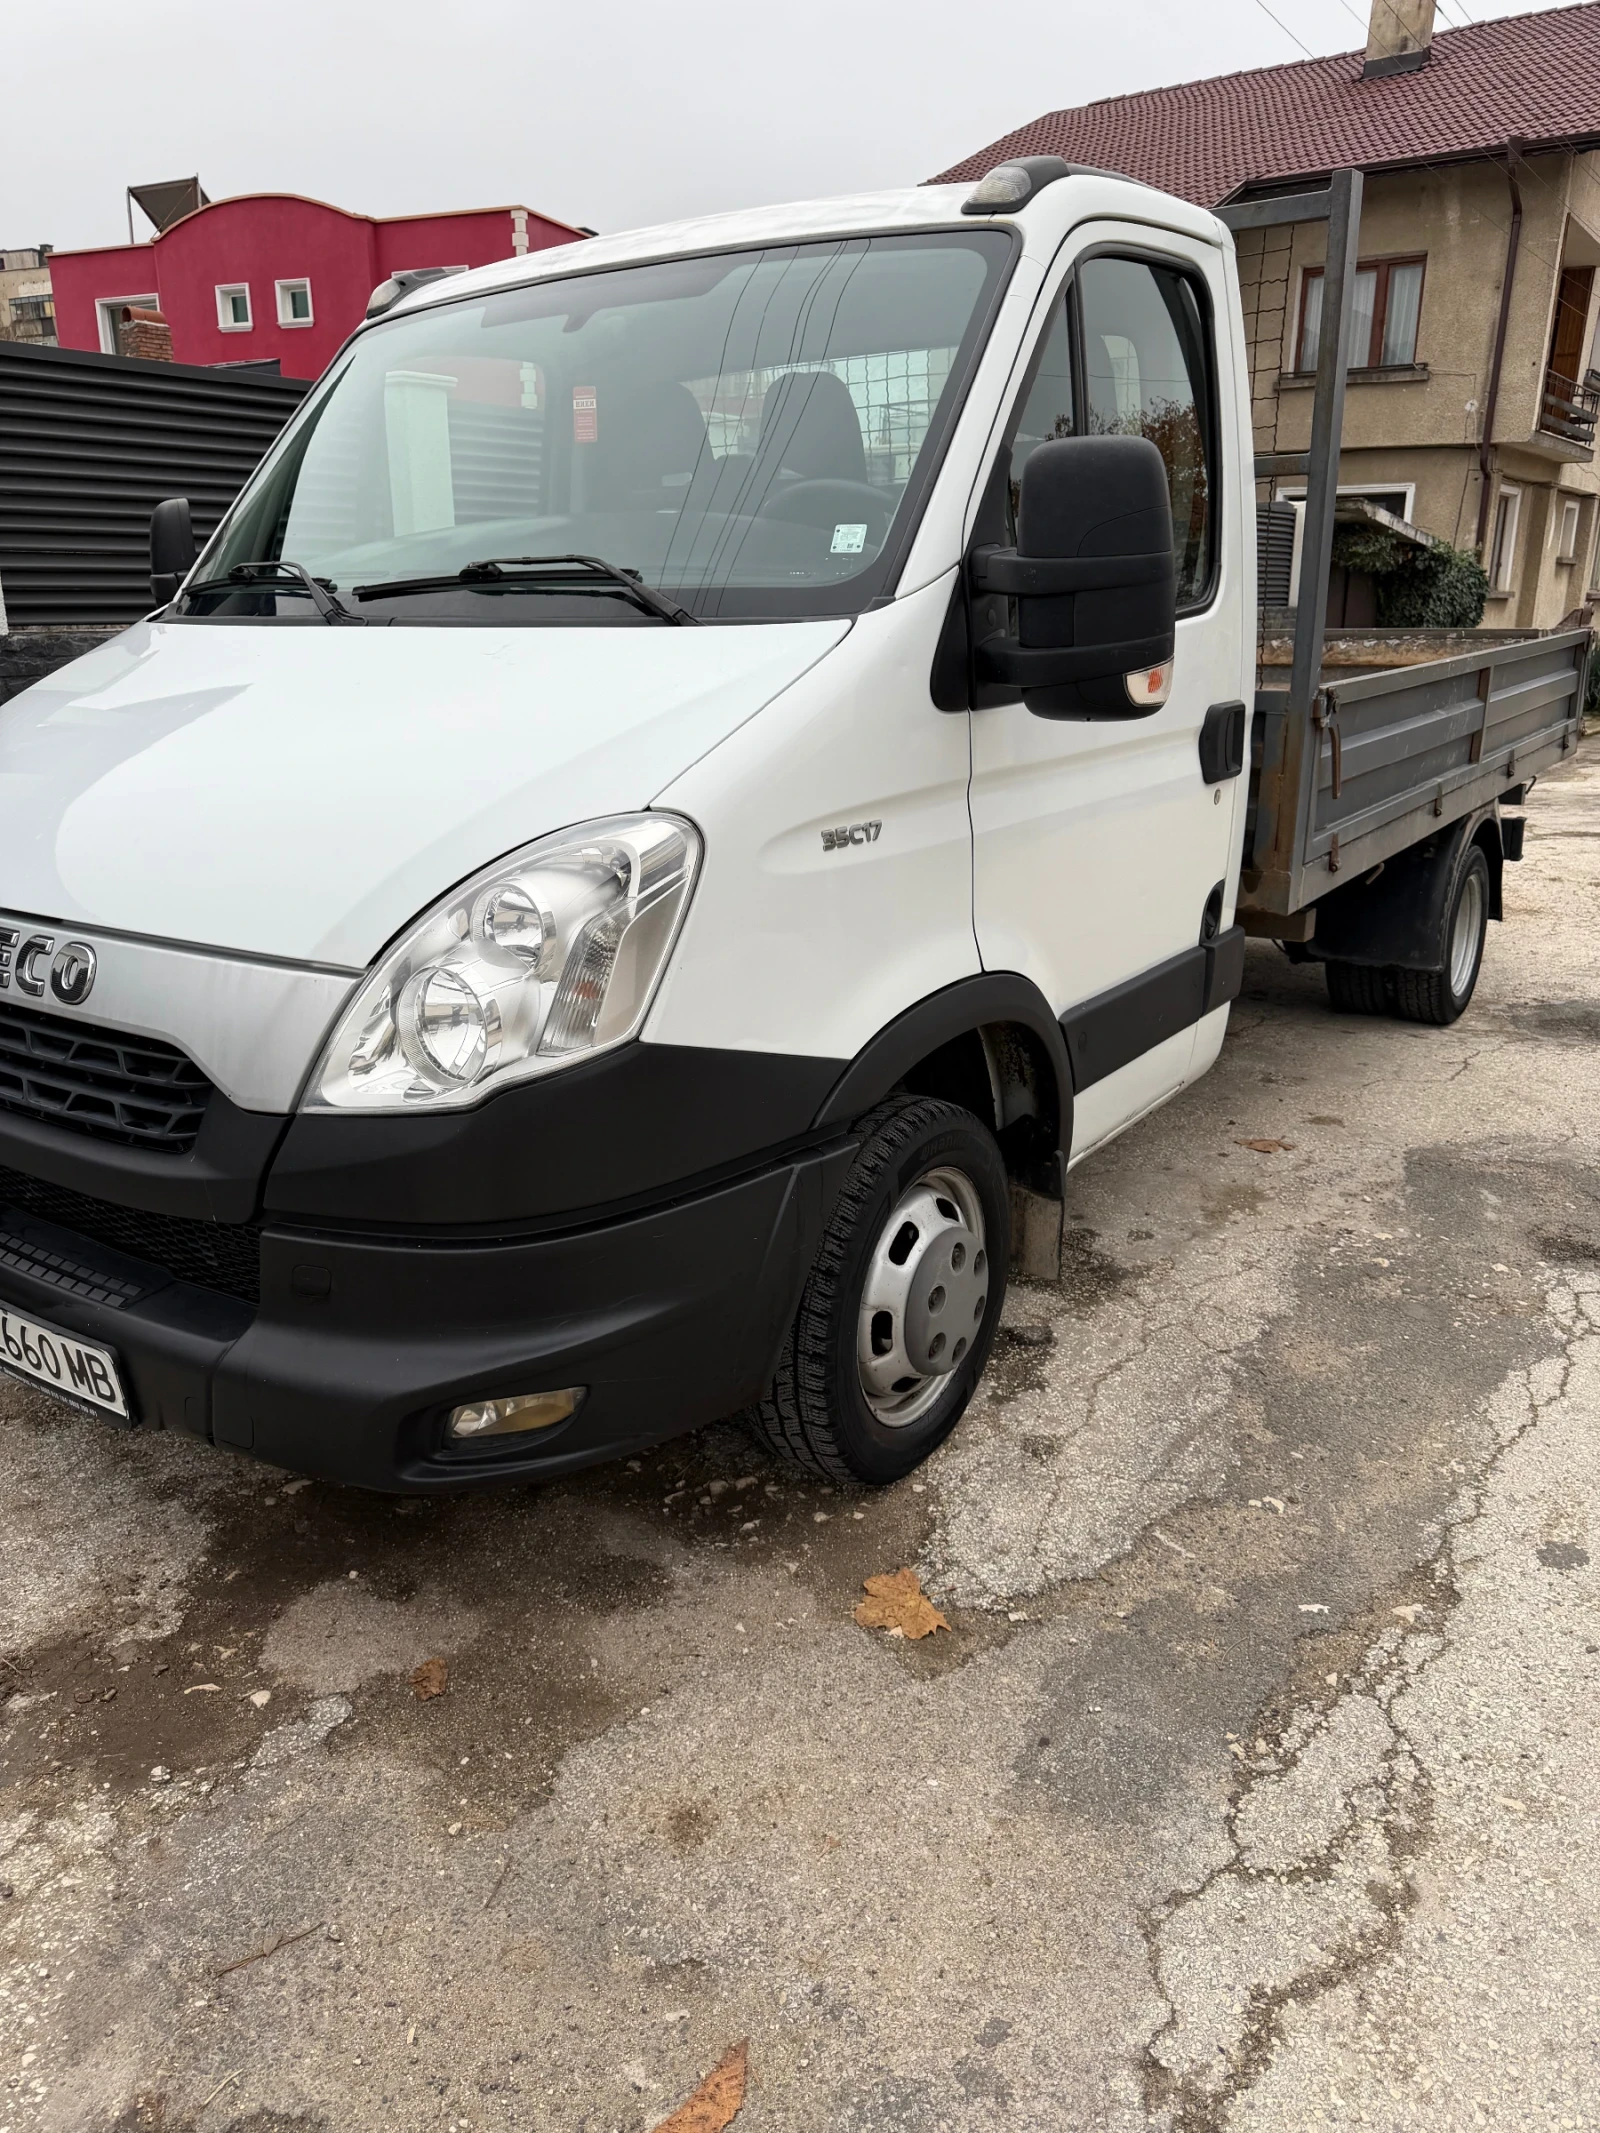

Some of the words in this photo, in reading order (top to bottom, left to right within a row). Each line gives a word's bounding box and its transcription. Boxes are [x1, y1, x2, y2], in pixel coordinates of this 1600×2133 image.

[821, 819, 882, 852] 35C17
[0, 1316, 61, 1380] 660
[60, 1342, 116, 1403] MB
